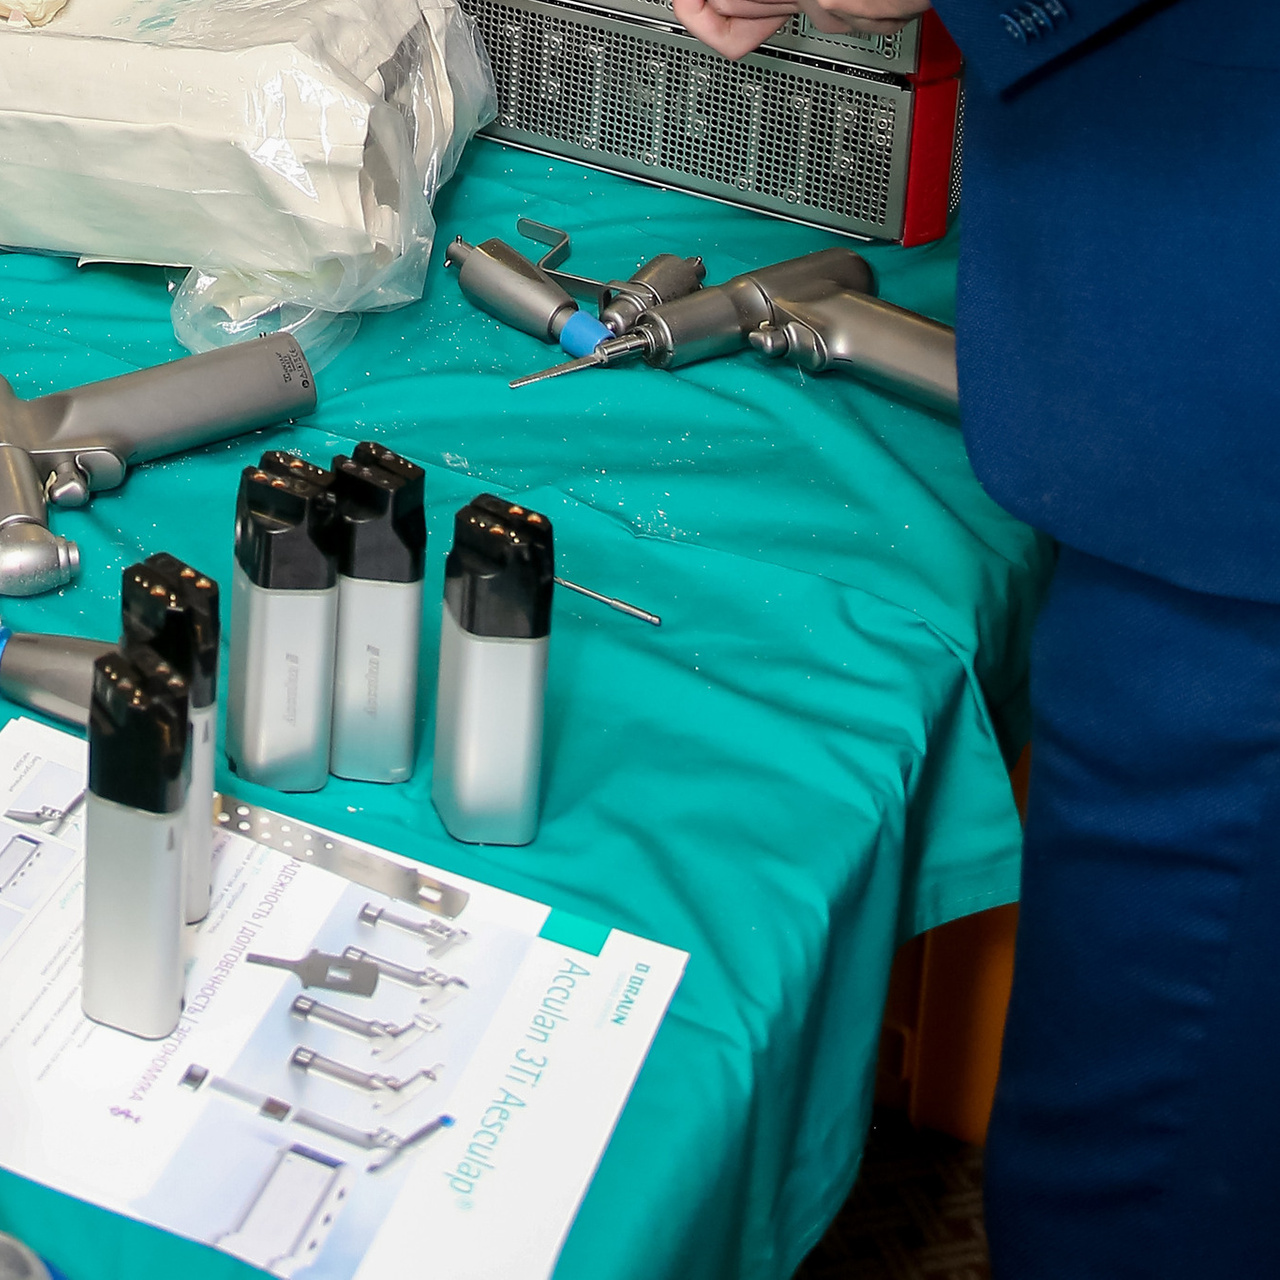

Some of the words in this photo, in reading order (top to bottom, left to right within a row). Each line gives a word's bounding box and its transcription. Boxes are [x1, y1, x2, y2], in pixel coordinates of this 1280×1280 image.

[252, 858, 302, 922] АДЕЖНОСТЬ
[187, 928, 256, 1015] ДОЛГОВЕЧНОСТЬ
[526, 958, 591, 1044] Acculan
[610, 975, 645, 1026] BRAUN
[505, 1048, 548, 1089] 3Ti
